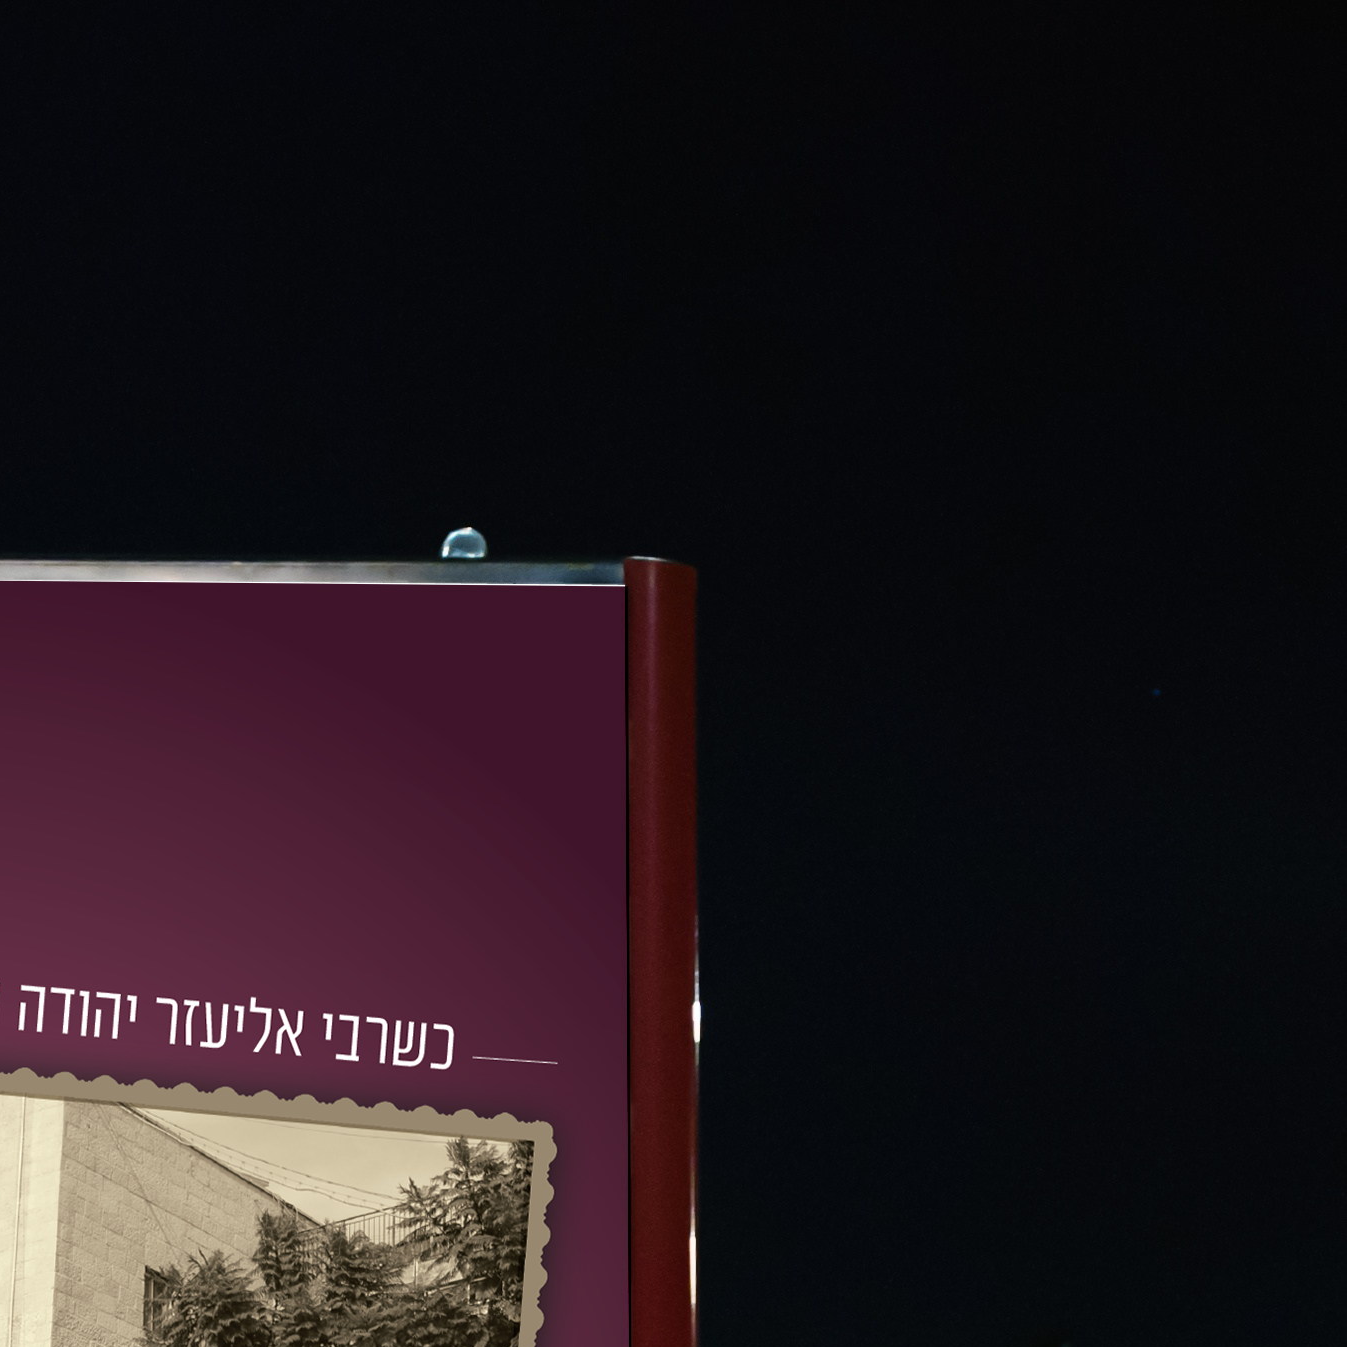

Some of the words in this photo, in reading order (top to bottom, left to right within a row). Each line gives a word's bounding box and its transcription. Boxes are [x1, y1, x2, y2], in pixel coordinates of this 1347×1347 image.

[18, 984, 138, 1040] יהודה
[156, 996, 305, 1057] אליעזר
[322, 1012, 456, 1070] כשרבי
